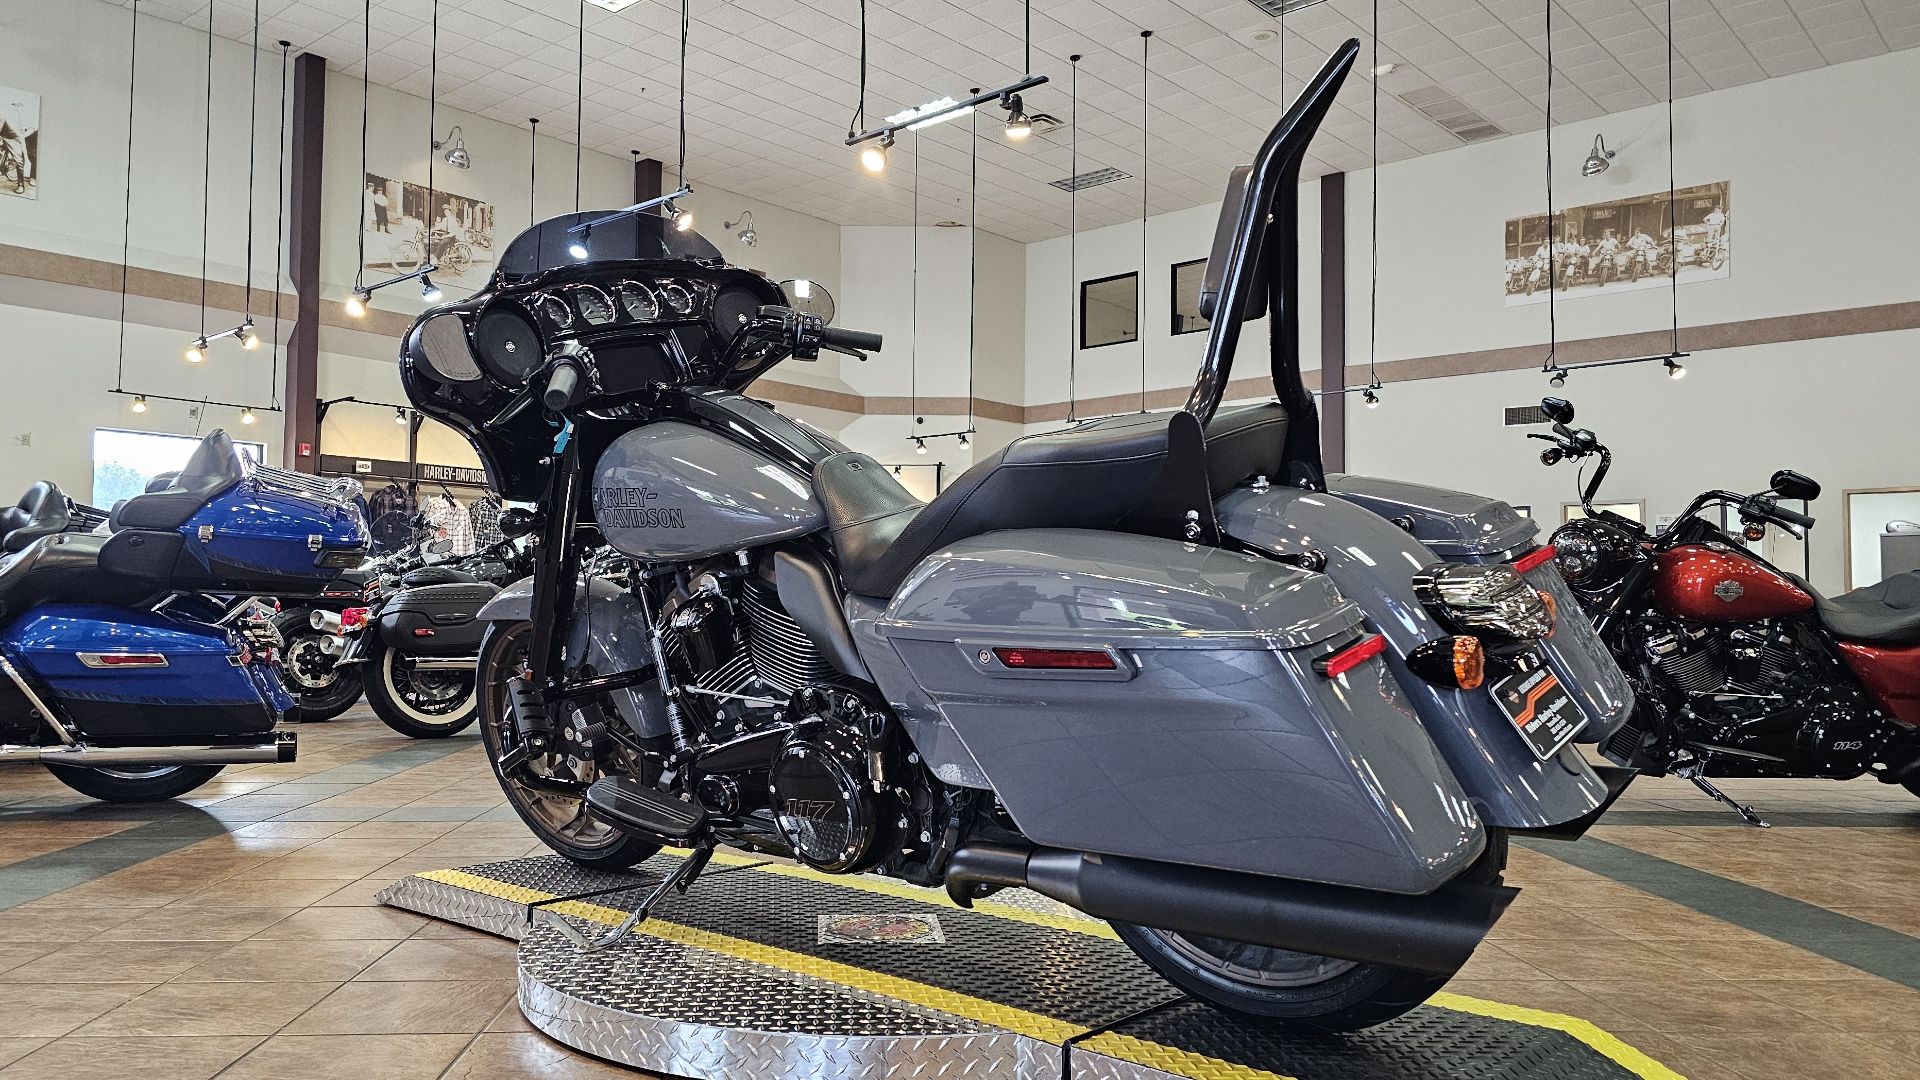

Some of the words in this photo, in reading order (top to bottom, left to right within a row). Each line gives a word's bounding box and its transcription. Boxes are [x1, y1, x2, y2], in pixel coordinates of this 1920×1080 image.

[424, 464, 488, 484] HARLEY-DAVIDSO
[598, 507, 685, 528] DAVIDSON
[1833, 740, 1863, 750] 114
[786, 798, 836, 822] 117
